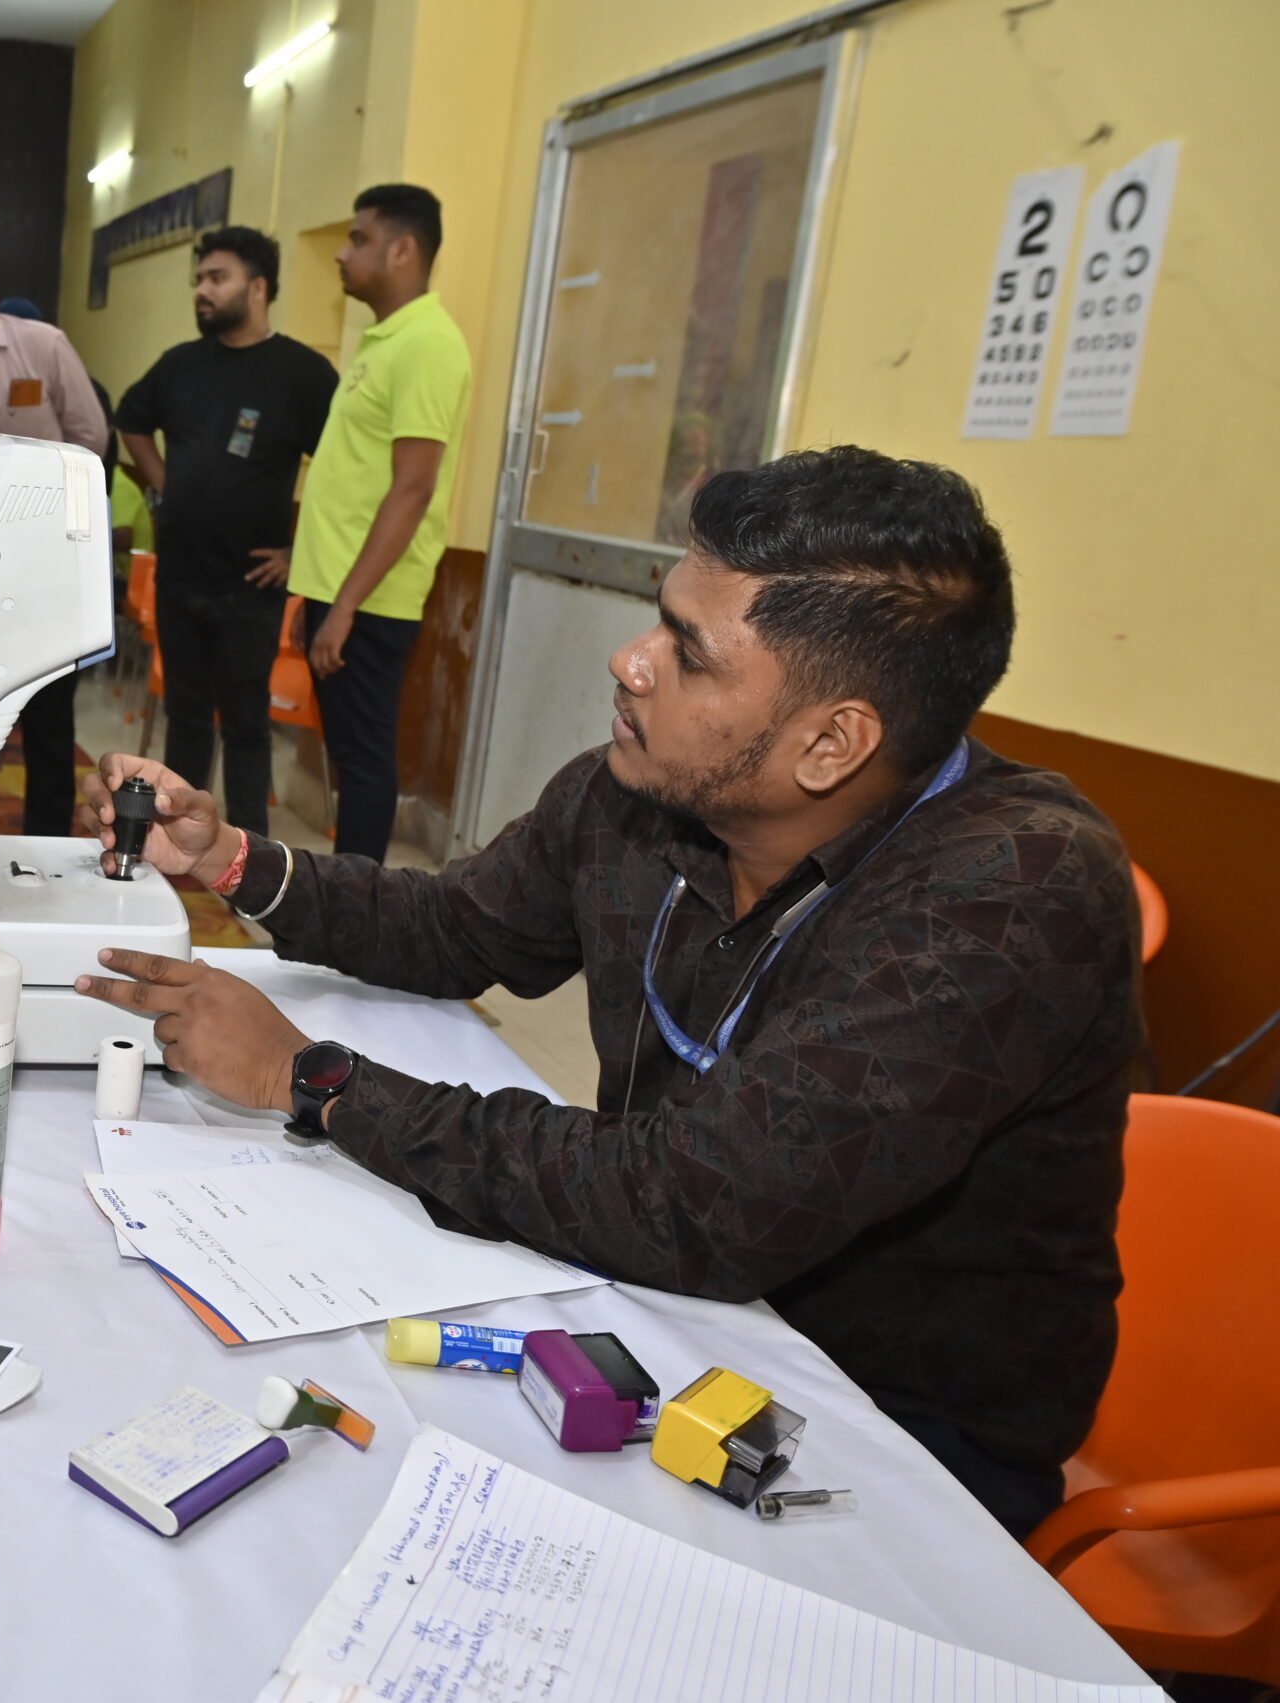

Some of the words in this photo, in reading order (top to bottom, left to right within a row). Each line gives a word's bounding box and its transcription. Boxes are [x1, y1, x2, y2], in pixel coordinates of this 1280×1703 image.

[1017, 198, 1054, 257] 2
[99, 1187, 122, 1211] hospital
[358, 1287, 380, 1306] Diagnosis
